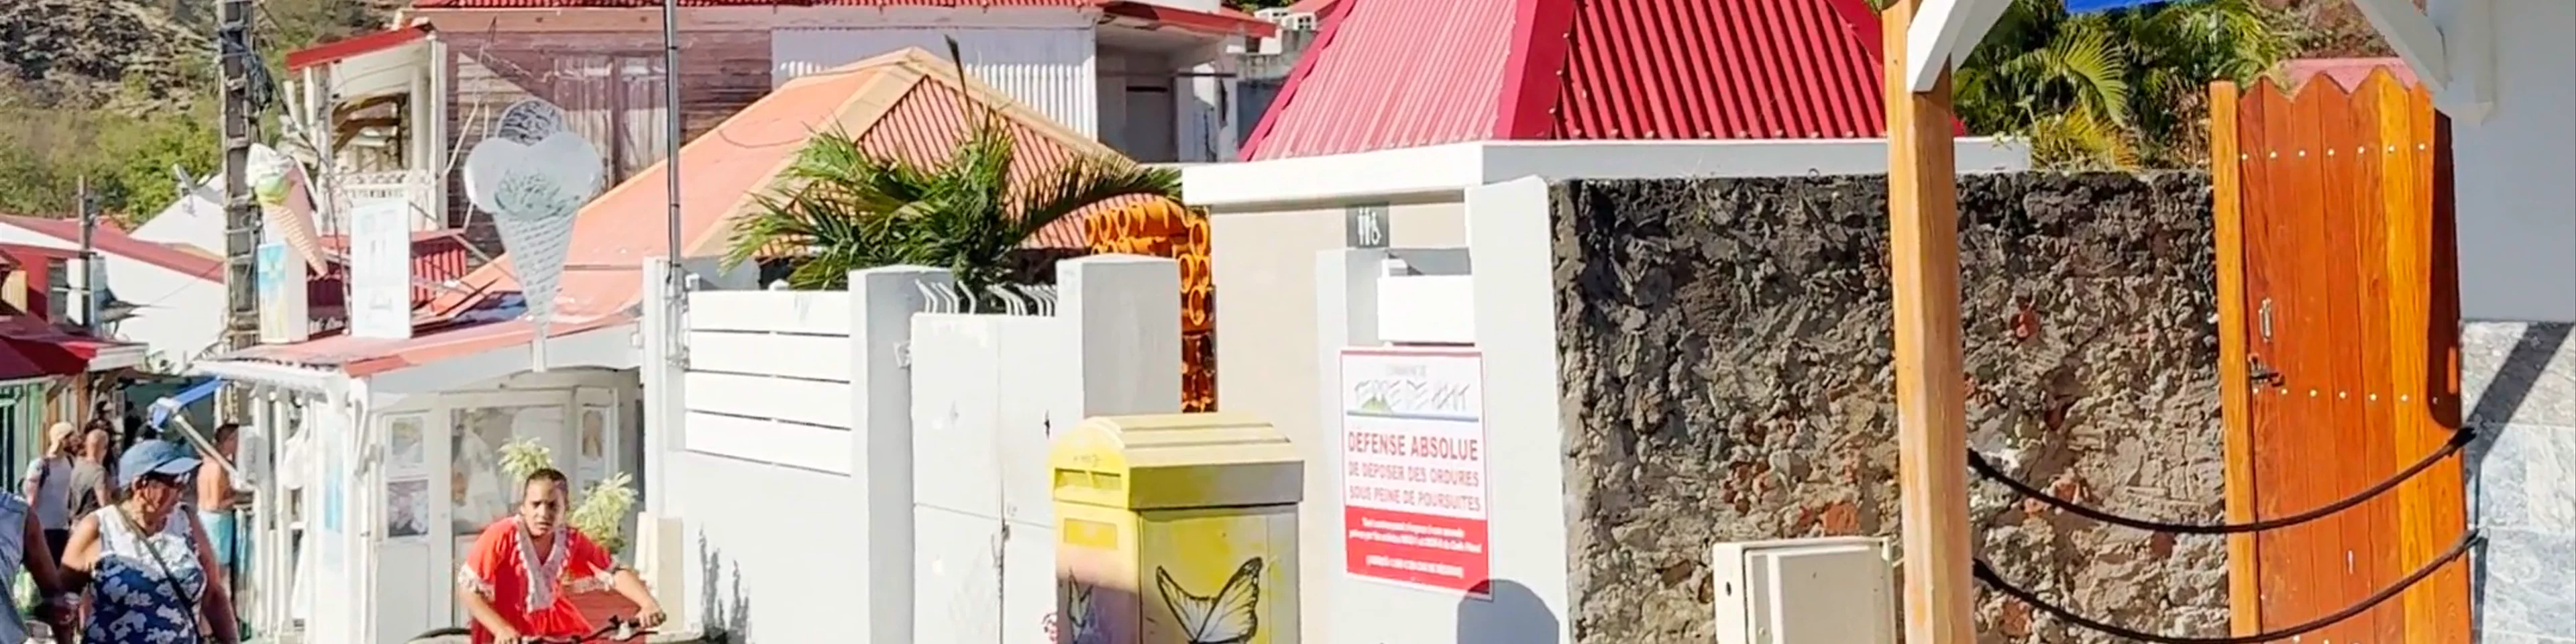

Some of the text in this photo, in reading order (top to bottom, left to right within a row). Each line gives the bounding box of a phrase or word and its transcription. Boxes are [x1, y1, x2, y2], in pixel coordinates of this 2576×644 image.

[1348, 431, 1479, 461] DEFENSE ABSOLUE
[1348, 462, 1479, 487] DE DEPOSER DES ORDURES
[1349, 485, 1481, 512] SOUS PEINE DE POURSUITES
